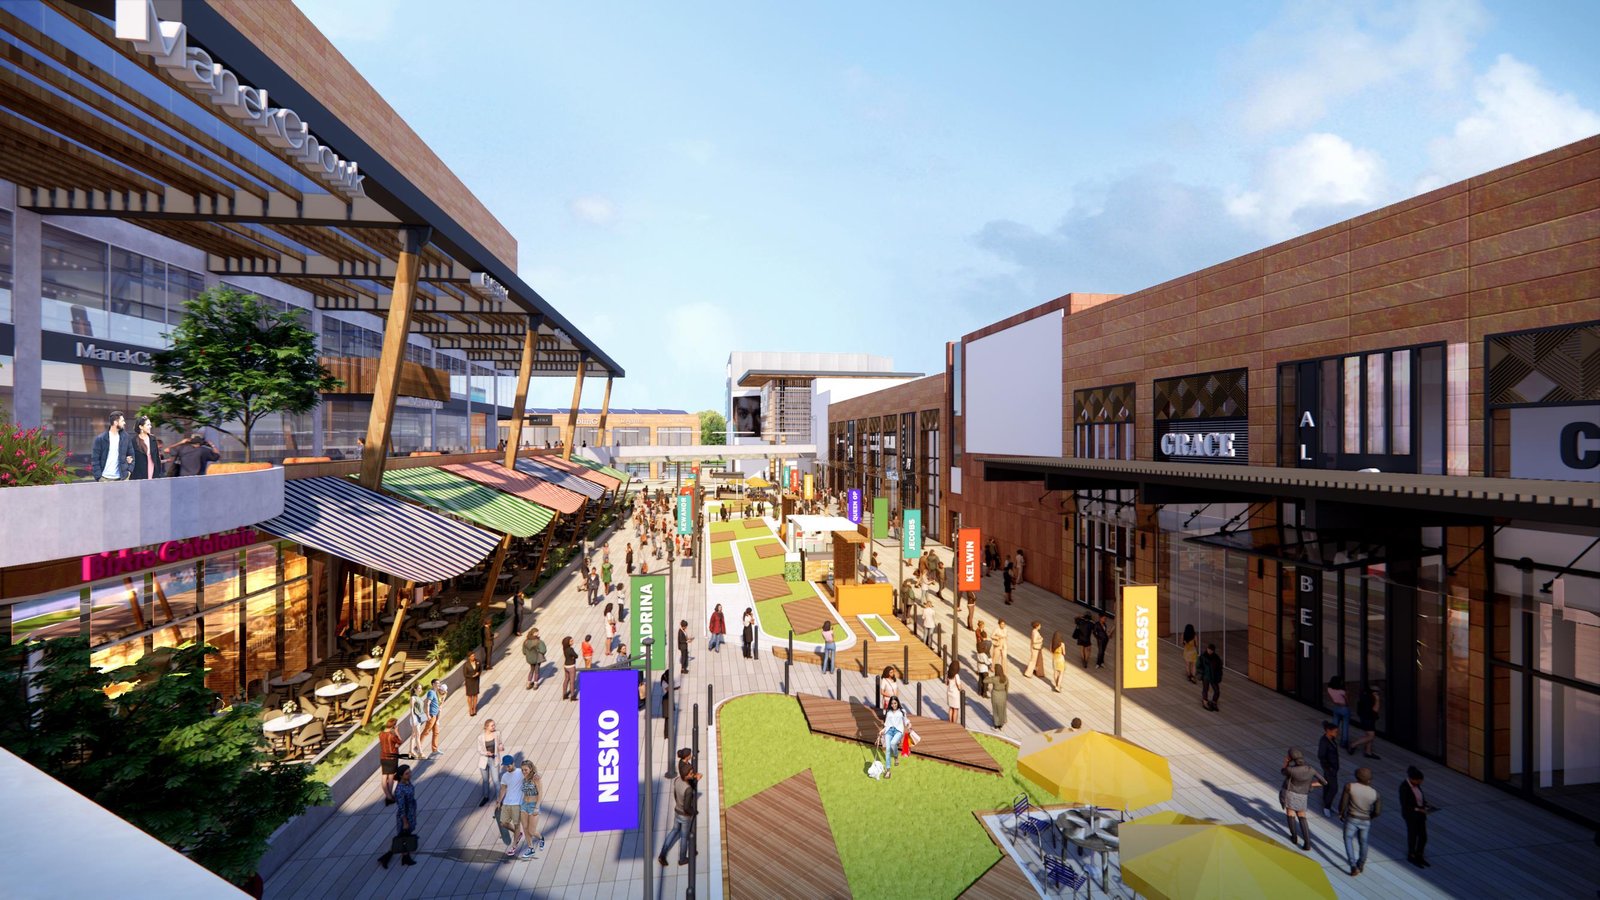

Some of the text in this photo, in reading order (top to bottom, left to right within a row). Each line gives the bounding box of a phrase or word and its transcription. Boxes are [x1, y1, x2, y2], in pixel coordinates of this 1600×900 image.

[76, 342, 151, 366] ManekC
[1161, 432, 1235, 457] GRACE
[82, 526, 257, 581] Bistro Catalonia
[966, 541, 974, 582] KELWIN
[1136, 605, 1149, 672] CLASSY
[598, 709, 619, 803] NESKO
